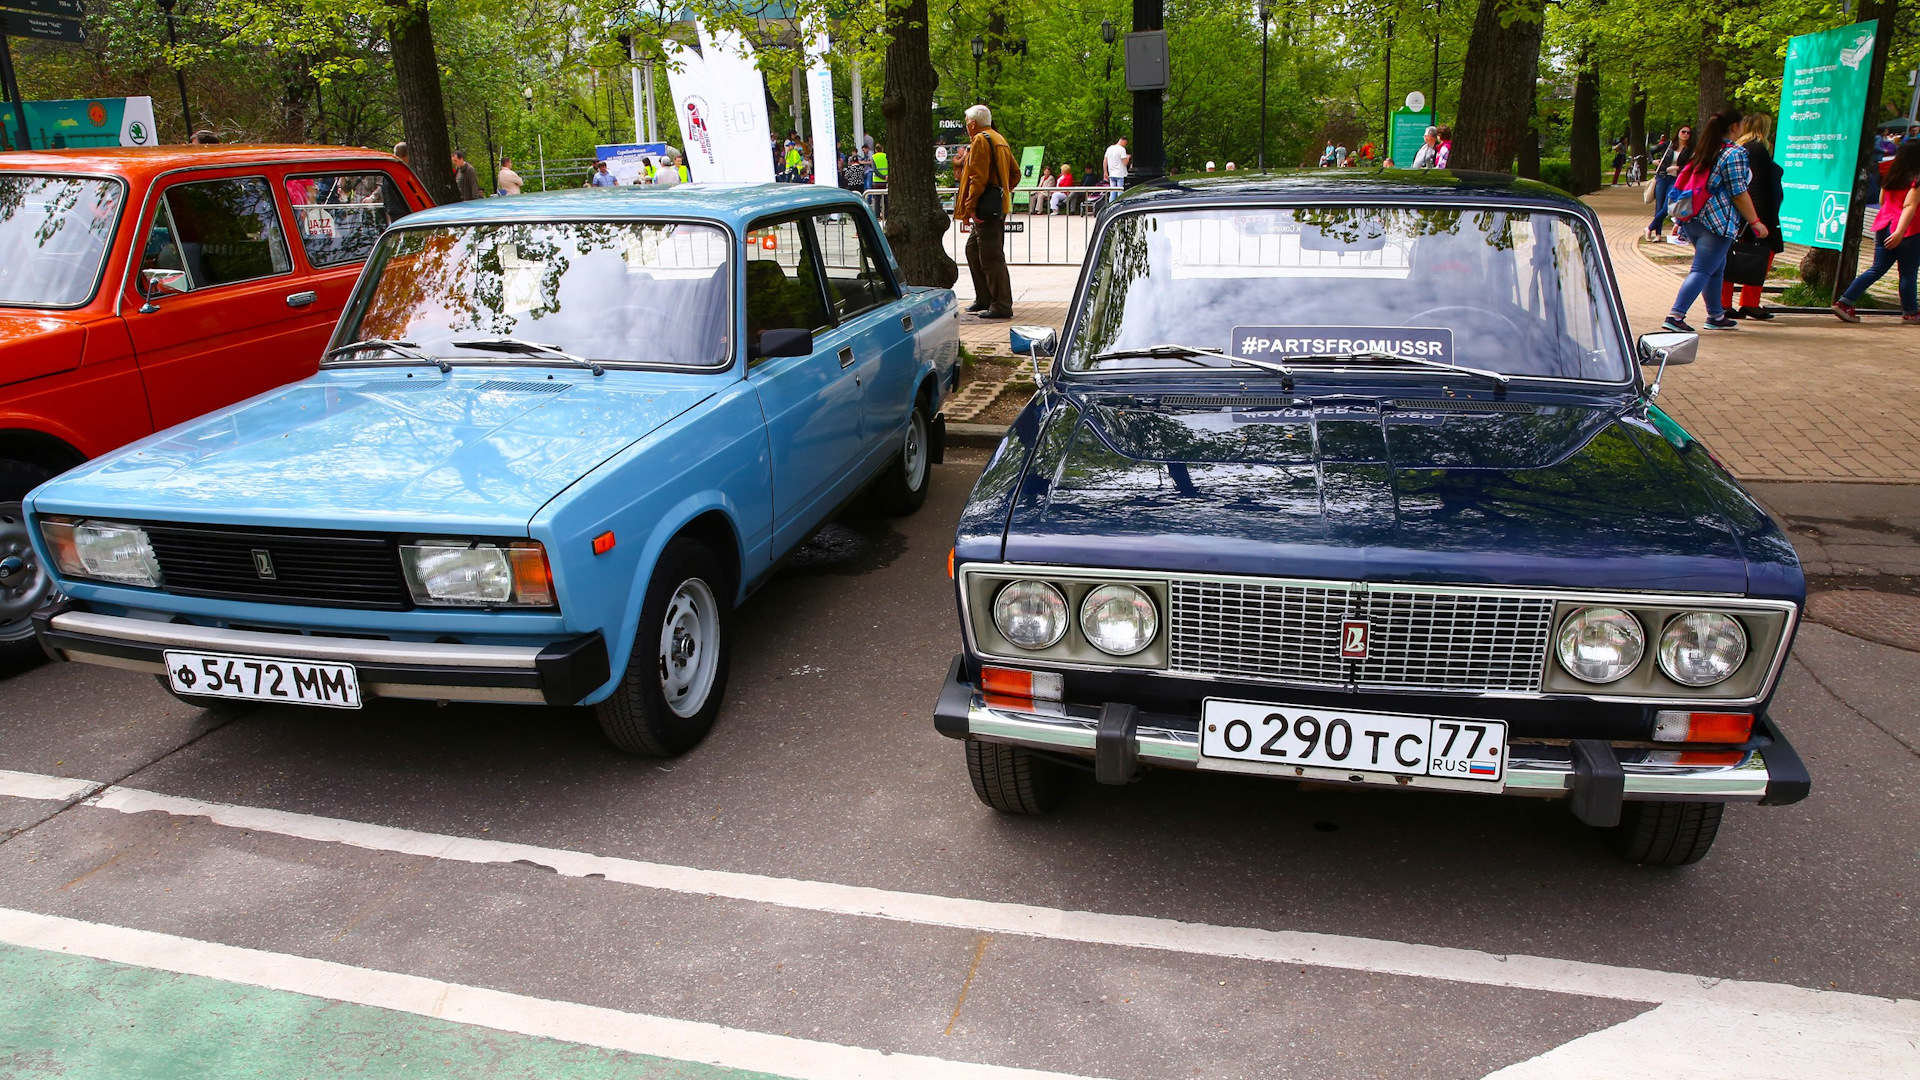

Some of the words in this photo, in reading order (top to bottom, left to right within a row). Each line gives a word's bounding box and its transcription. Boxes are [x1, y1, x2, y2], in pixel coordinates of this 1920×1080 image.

[309, 218, 332, 230] JAZZ
[1241, 337, 1443, 356] #PARTSFROMUSSR
[202, 658, 288, 697] 5472
[1438, 723, 1487, 759] 77
[1432, 759, 1468, 773] RUS
